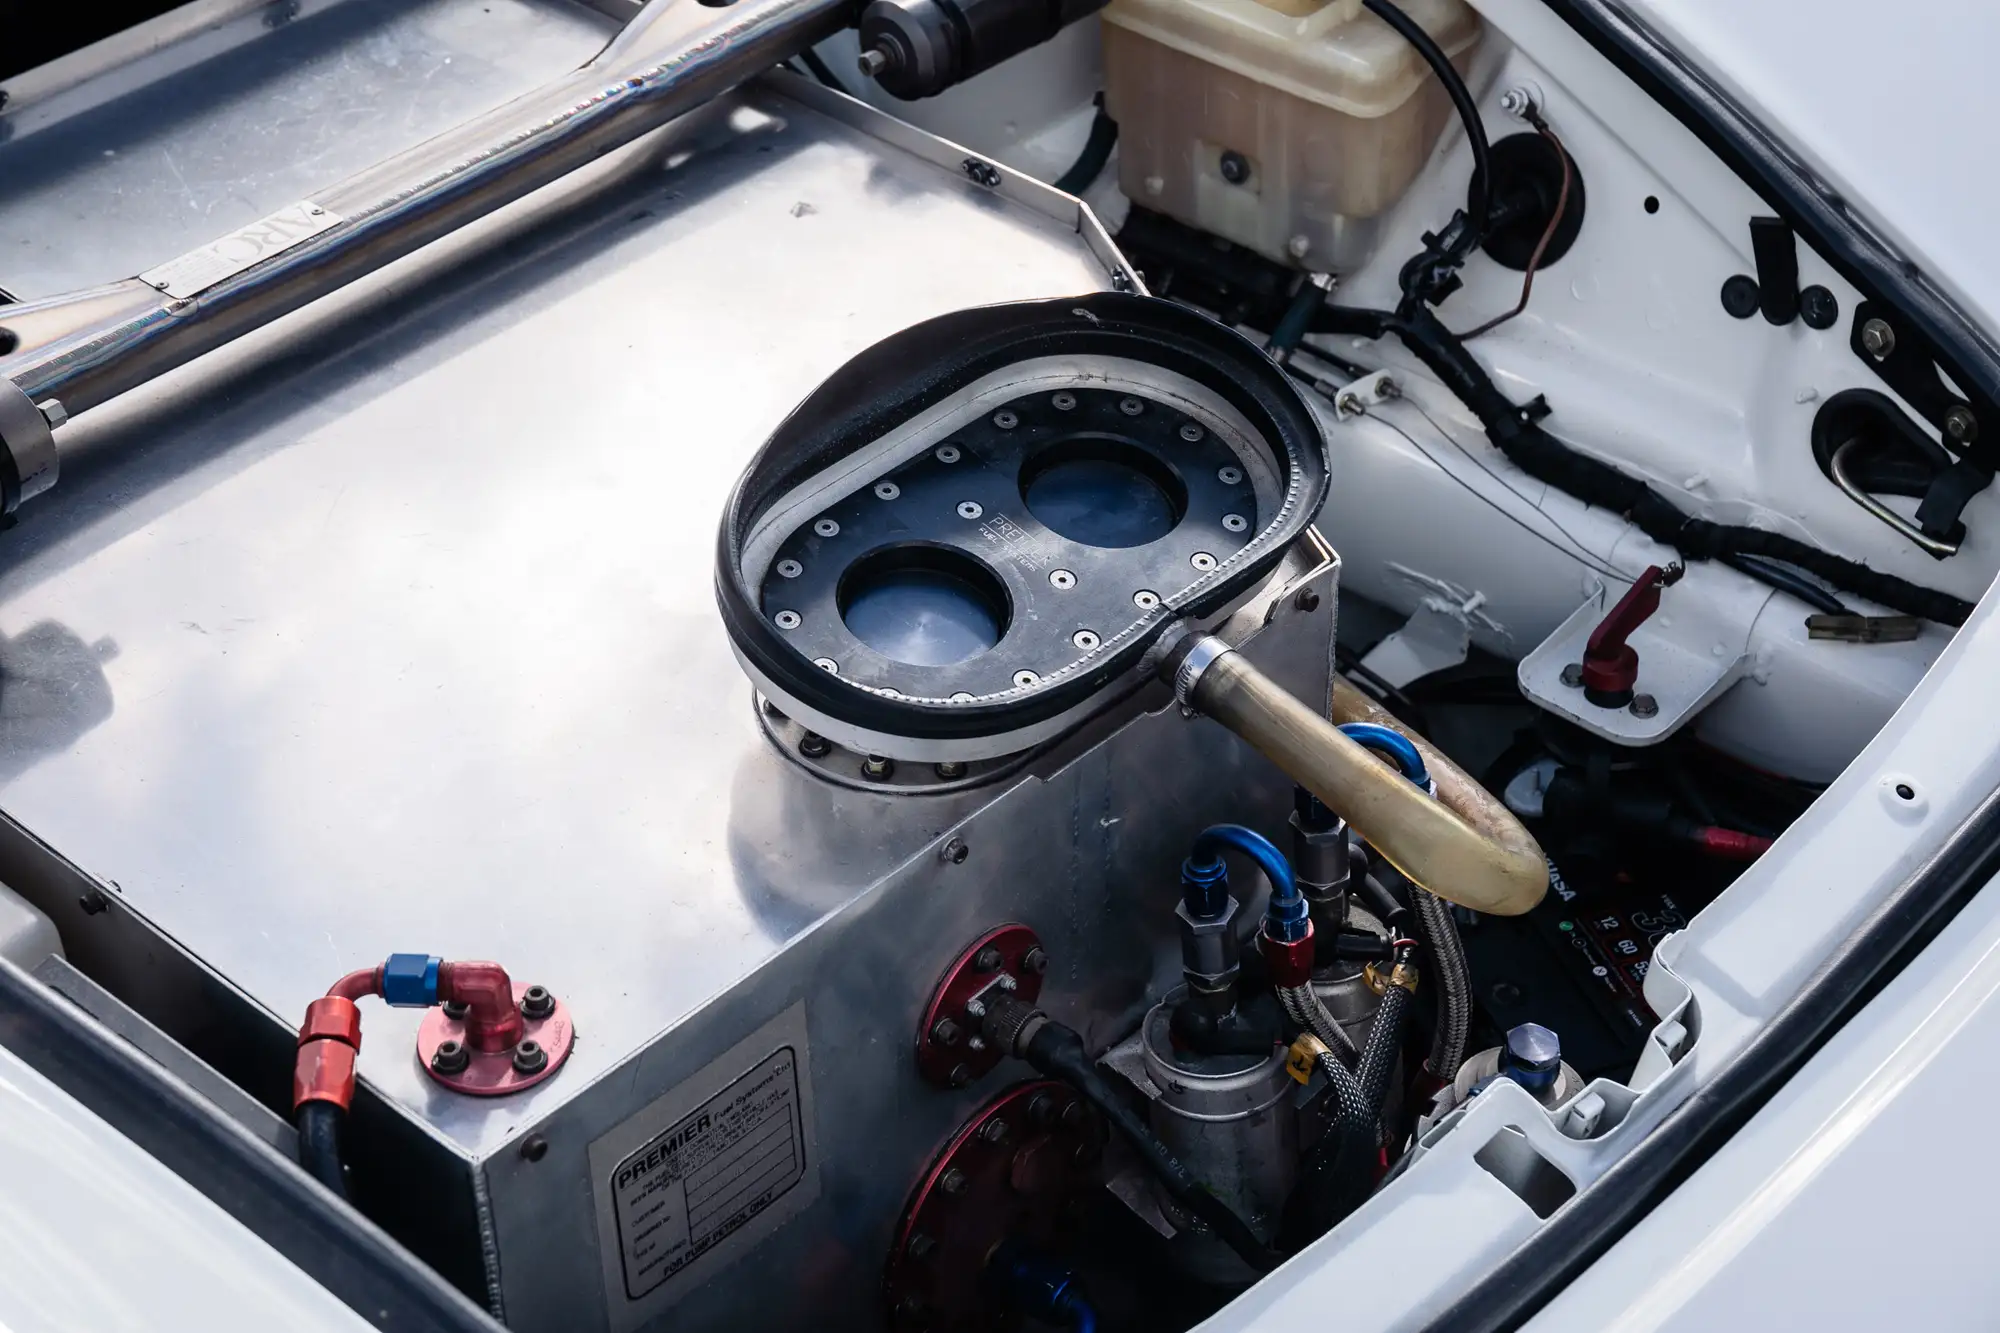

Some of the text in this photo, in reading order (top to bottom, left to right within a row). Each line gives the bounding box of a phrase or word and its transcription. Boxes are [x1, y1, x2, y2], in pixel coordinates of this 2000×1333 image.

[211, 205, 316, 263] ARC
[978, 527, 999, 545] FUEL
[1601, 915, 1619, 930] 12
[1618, 939, 1638, 955] 60
[618, 1113, 712, 1190] PREMIER
[714, 1101, 734, 1122] Fuel
[735, 1075, 774, 1106] Systems
[663, 1253, 684, 1276] FOR
[685, 1235, 711, 1261] PUMP
[712, 1211, 748, 1242] PETROL
[749, 1190, 773, 1214] ONLY
